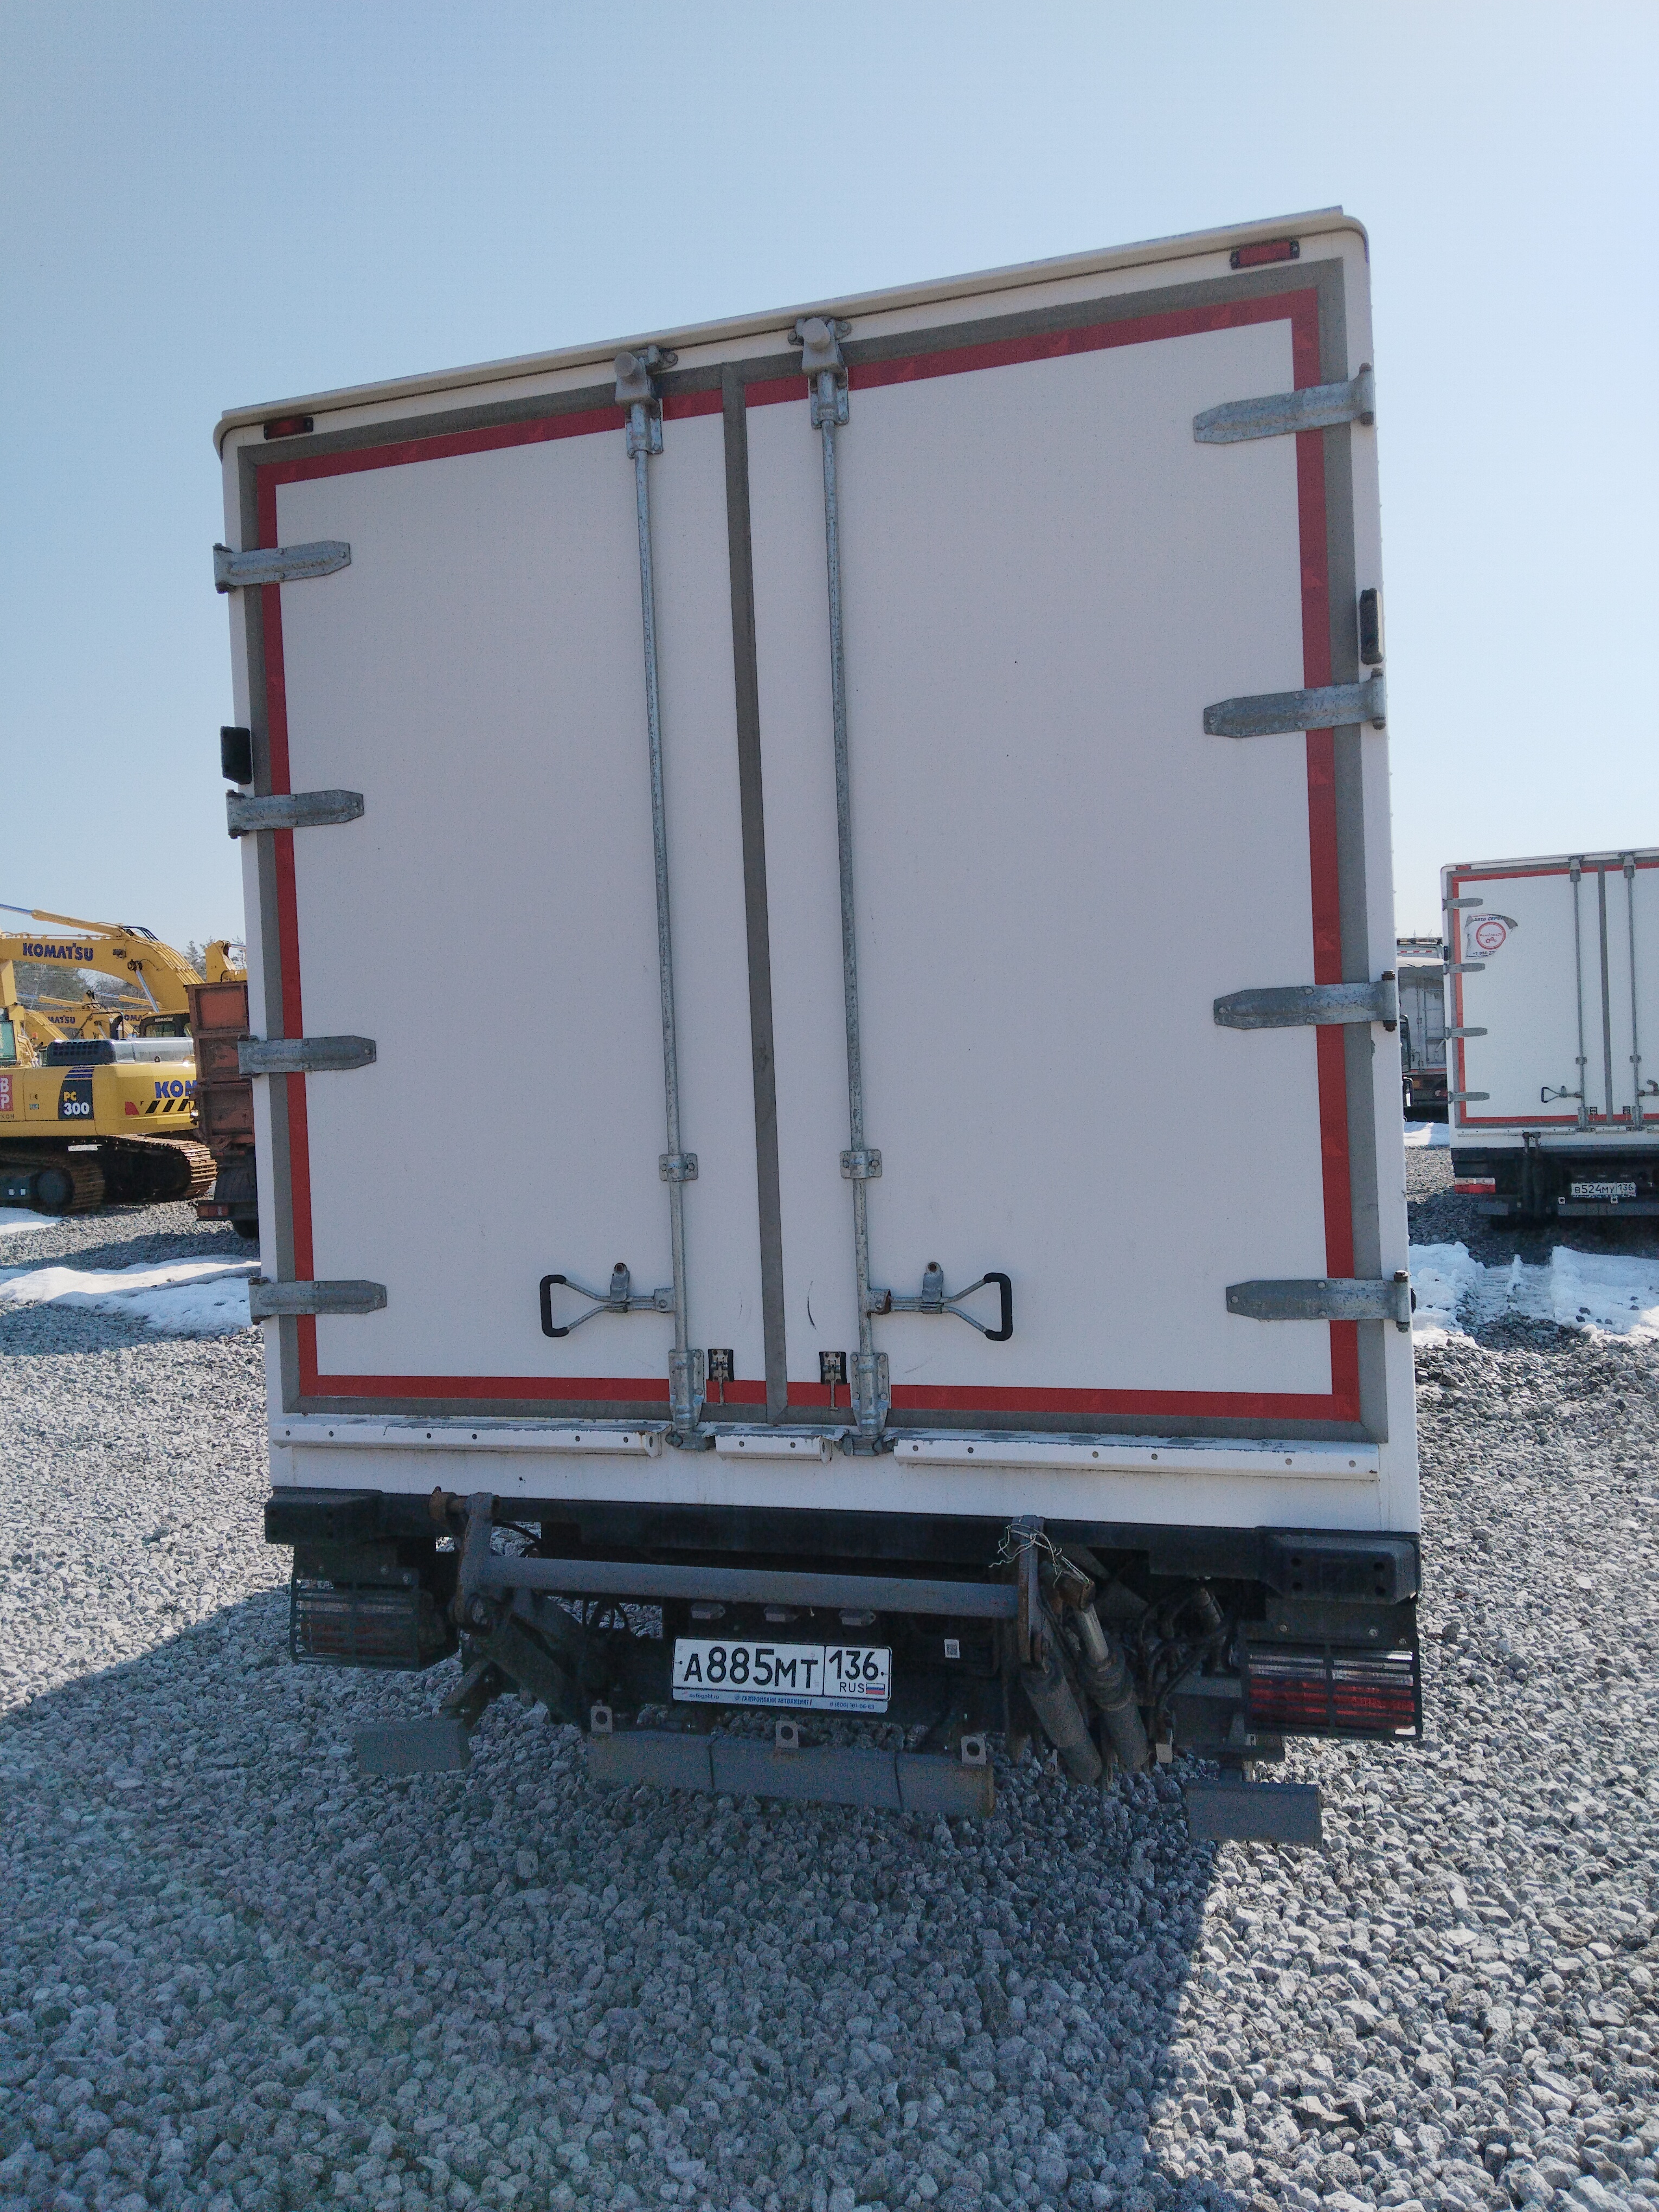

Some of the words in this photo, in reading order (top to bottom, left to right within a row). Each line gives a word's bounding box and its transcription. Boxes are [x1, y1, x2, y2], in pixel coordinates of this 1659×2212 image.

[23, 943, 94, 961] KOMATSU
[63, 1091, 77, 1101] PC
[63, 1102, 90, 1115] 300
[684, 1646, 818, 1689] А885МТ
[828, 1649, 879, 1681] 136
[839, 1681, 865, 1693] RUS
